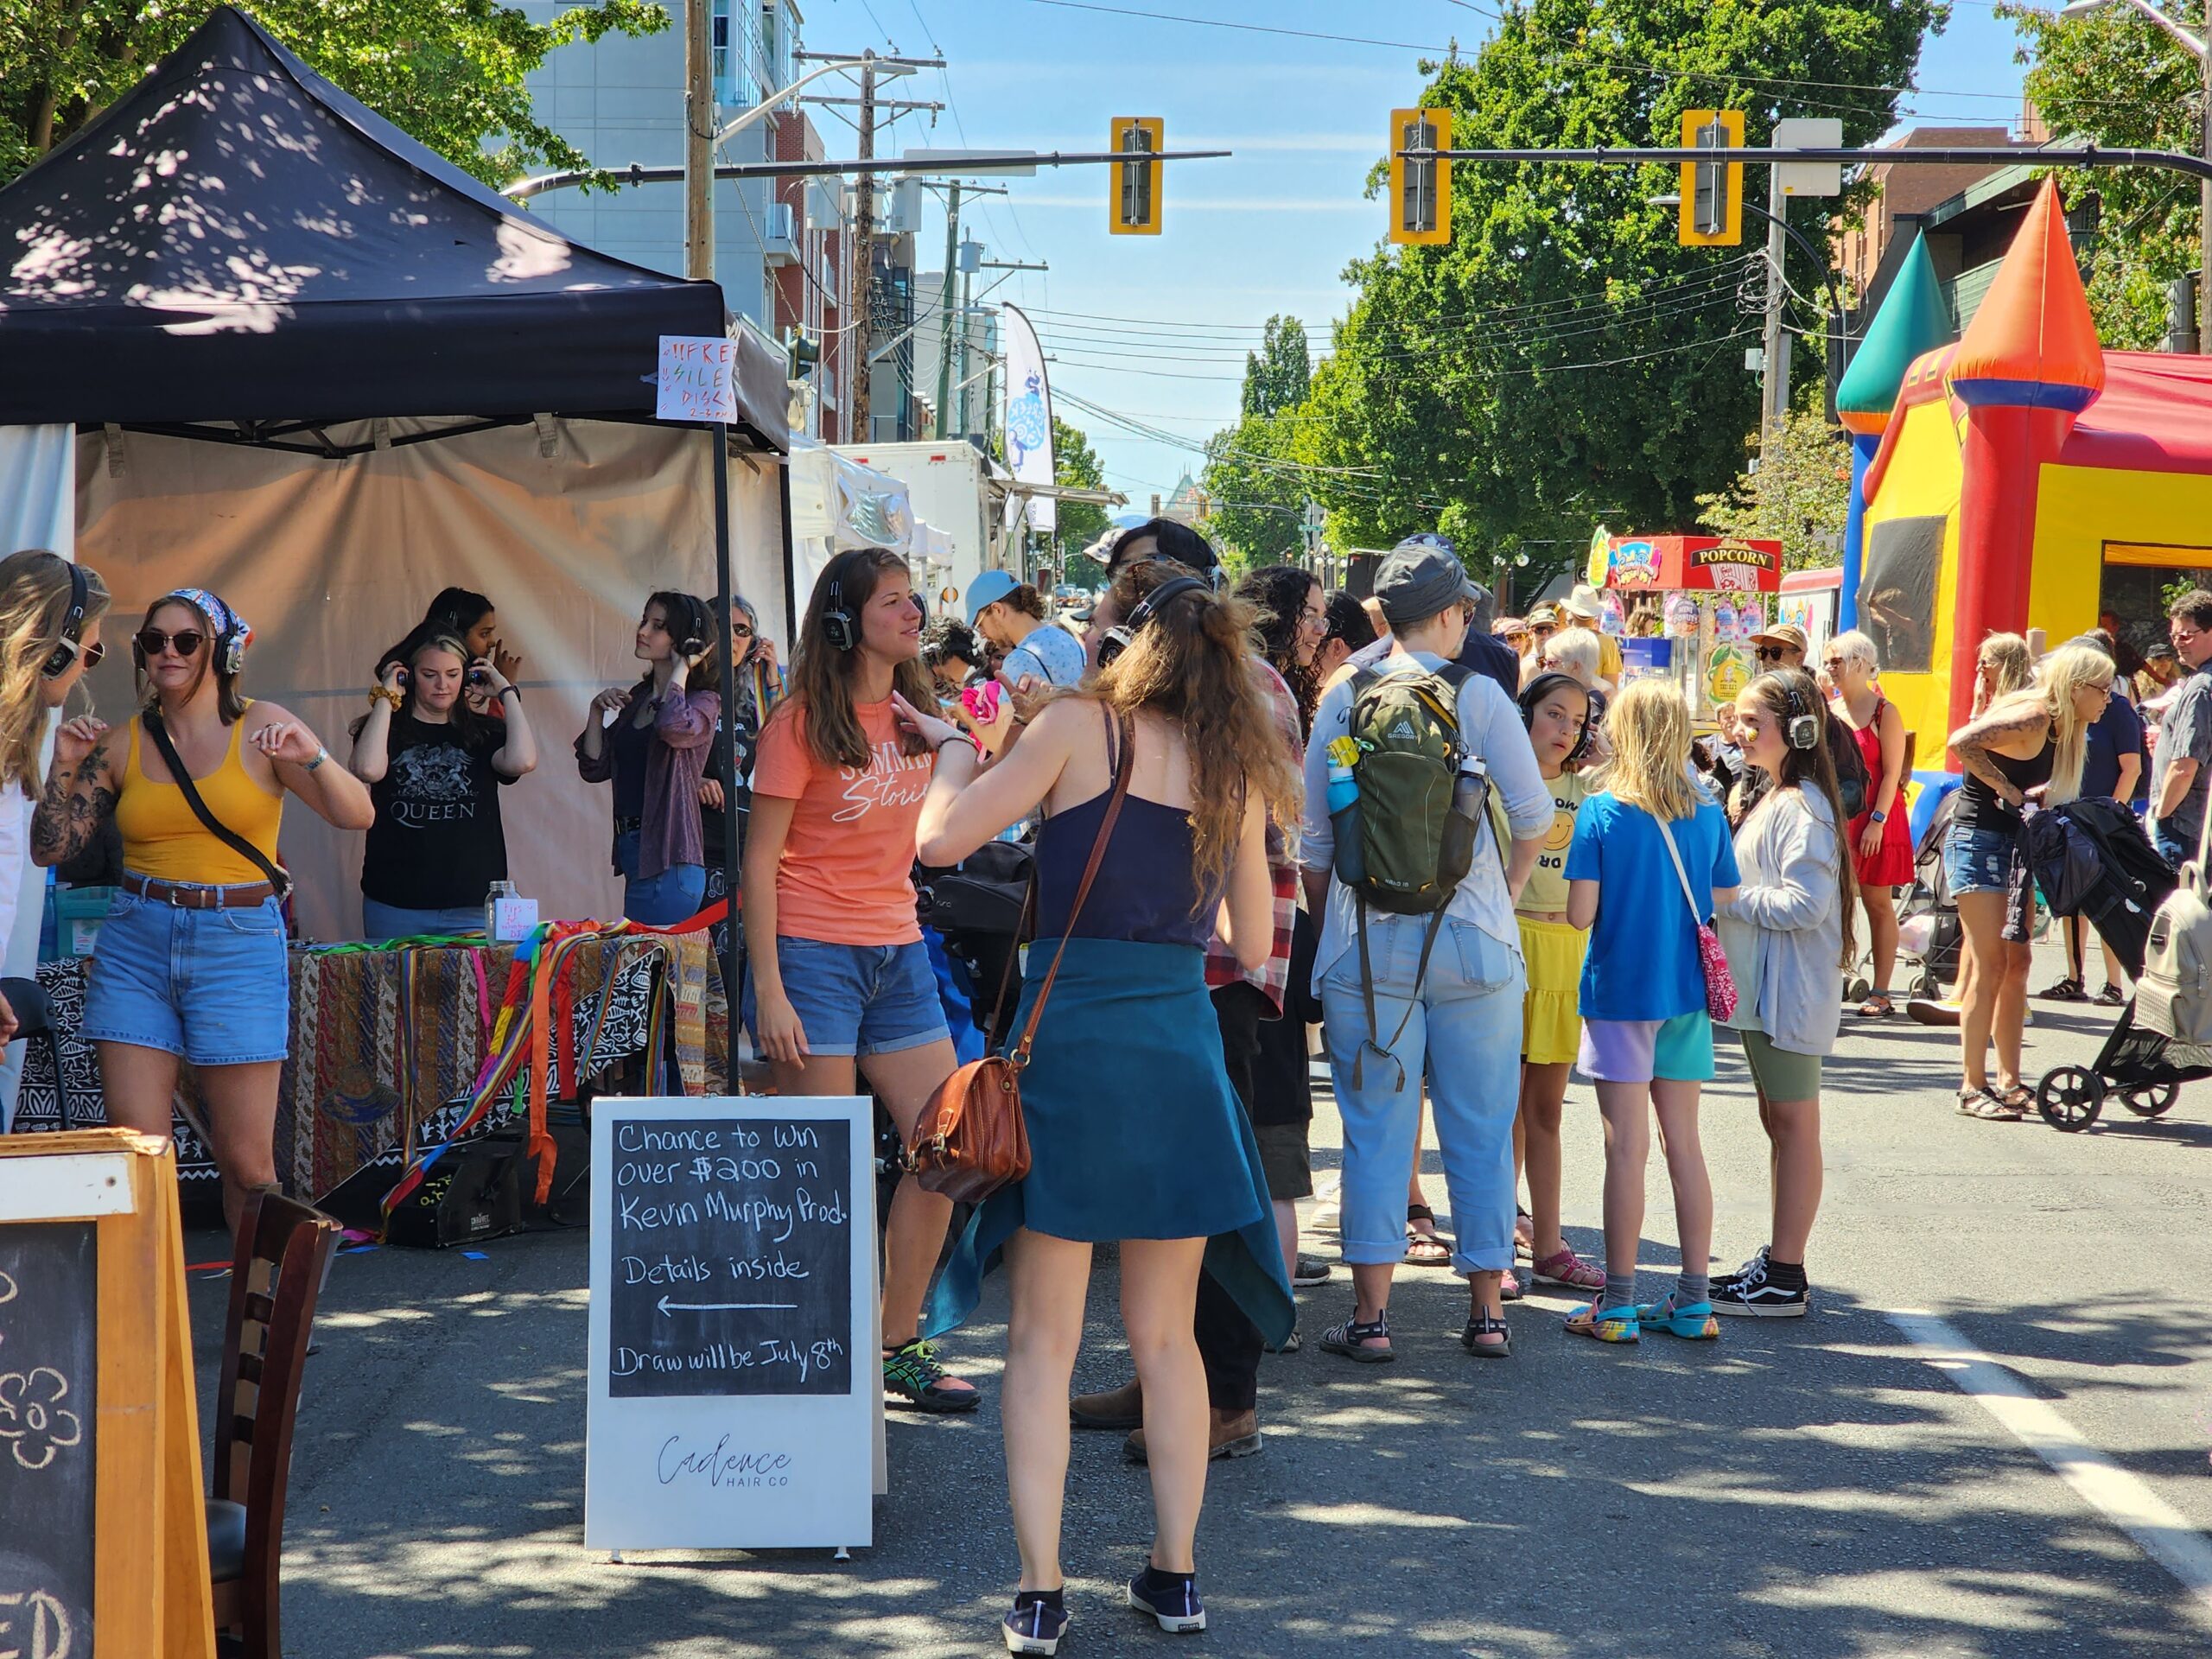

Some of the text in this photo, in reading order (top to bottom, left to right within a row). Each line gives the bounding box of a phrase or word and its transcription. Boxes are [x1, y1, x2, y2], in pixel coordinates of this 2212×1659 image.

[1700, 550, 1768, 566] POPCORN
[390, 800, 476, 828] QUEEN
[619, 1124, 721, 1152] Chance
[731, 1123, 760, 1148] to
[617, 1156, 819, 1186] over $200 in
[620, 1186, 848, 1243] Kevin Murphy Prod.
[621, 1249, 810, 1285] Details inside
[612, 1338, 844, 1383] Draw will be July 8th
[658, 1433, 792, 1487] Cadence
[727, 1476, 788, 1487] HAIR CO
